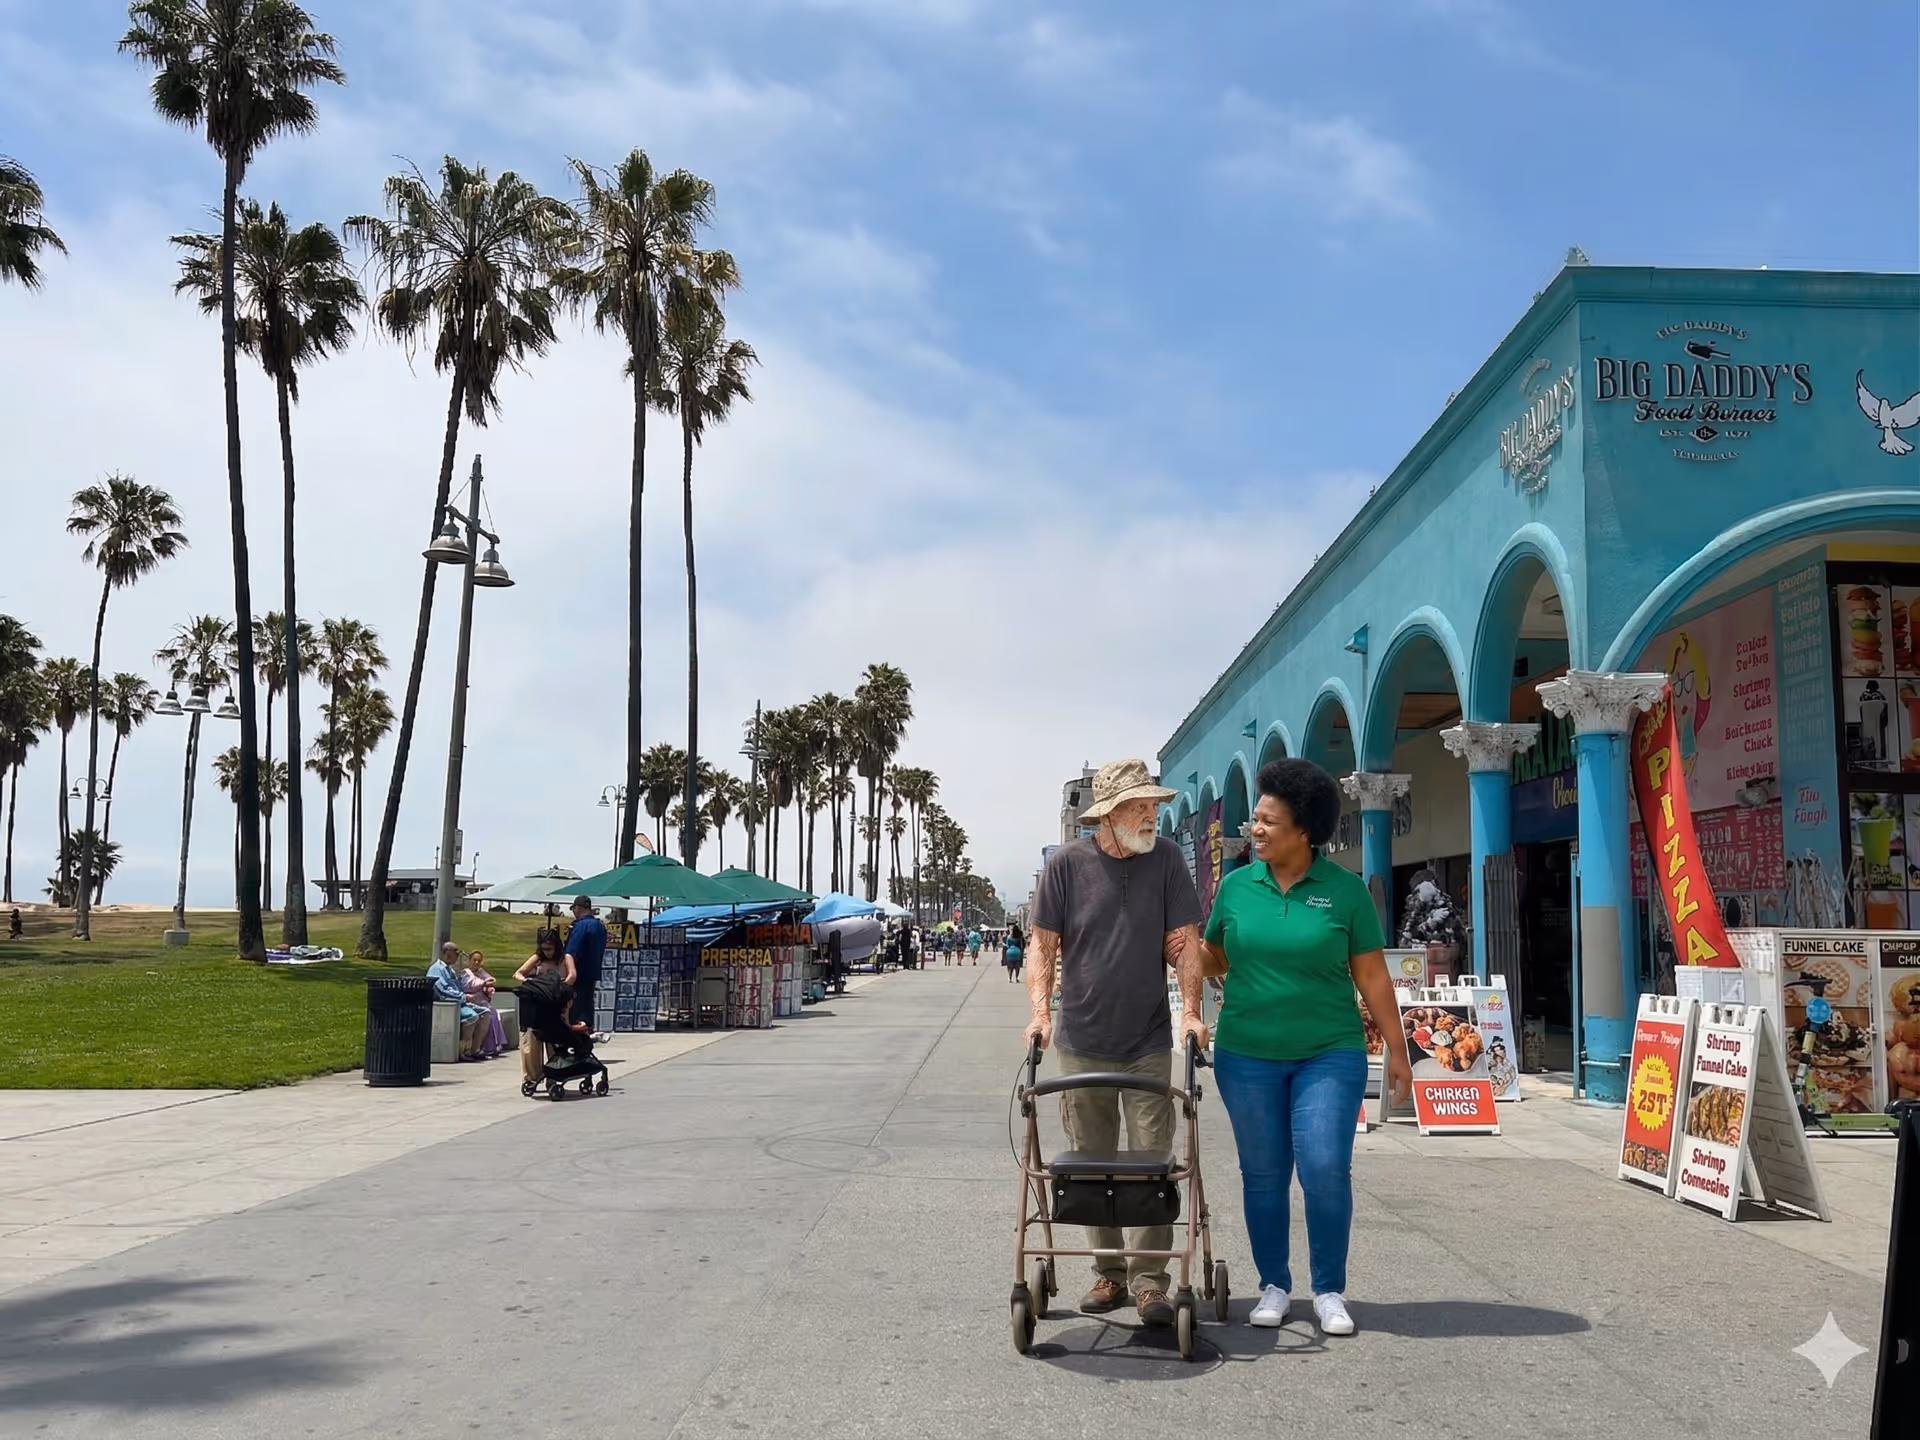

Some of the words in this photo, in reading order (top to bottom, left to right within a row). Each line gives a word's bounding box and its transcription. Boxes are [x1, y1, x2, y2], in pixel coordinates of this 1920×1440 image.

[1593, 356, 1652, 401] BIG
[1663, 361, 1814, 404] DADDY'S
[1634, 399, 1695, 422] Food
[1647, 747, 1719, 965] PIZZA
[1784, 941, 1830, 953] FUNNEL
[1832, 941, 1865, 953] CAKE
[1706, 1033, 1741, 1056] Shrimp
[1696, 1055, 1724, 1073] Funnel
[1725, 1059, 1747, 1078] Cake
[1432, 1102, 1478, 1116] WINGS
[1692, 1147, 1726, 1175] Shrimp
